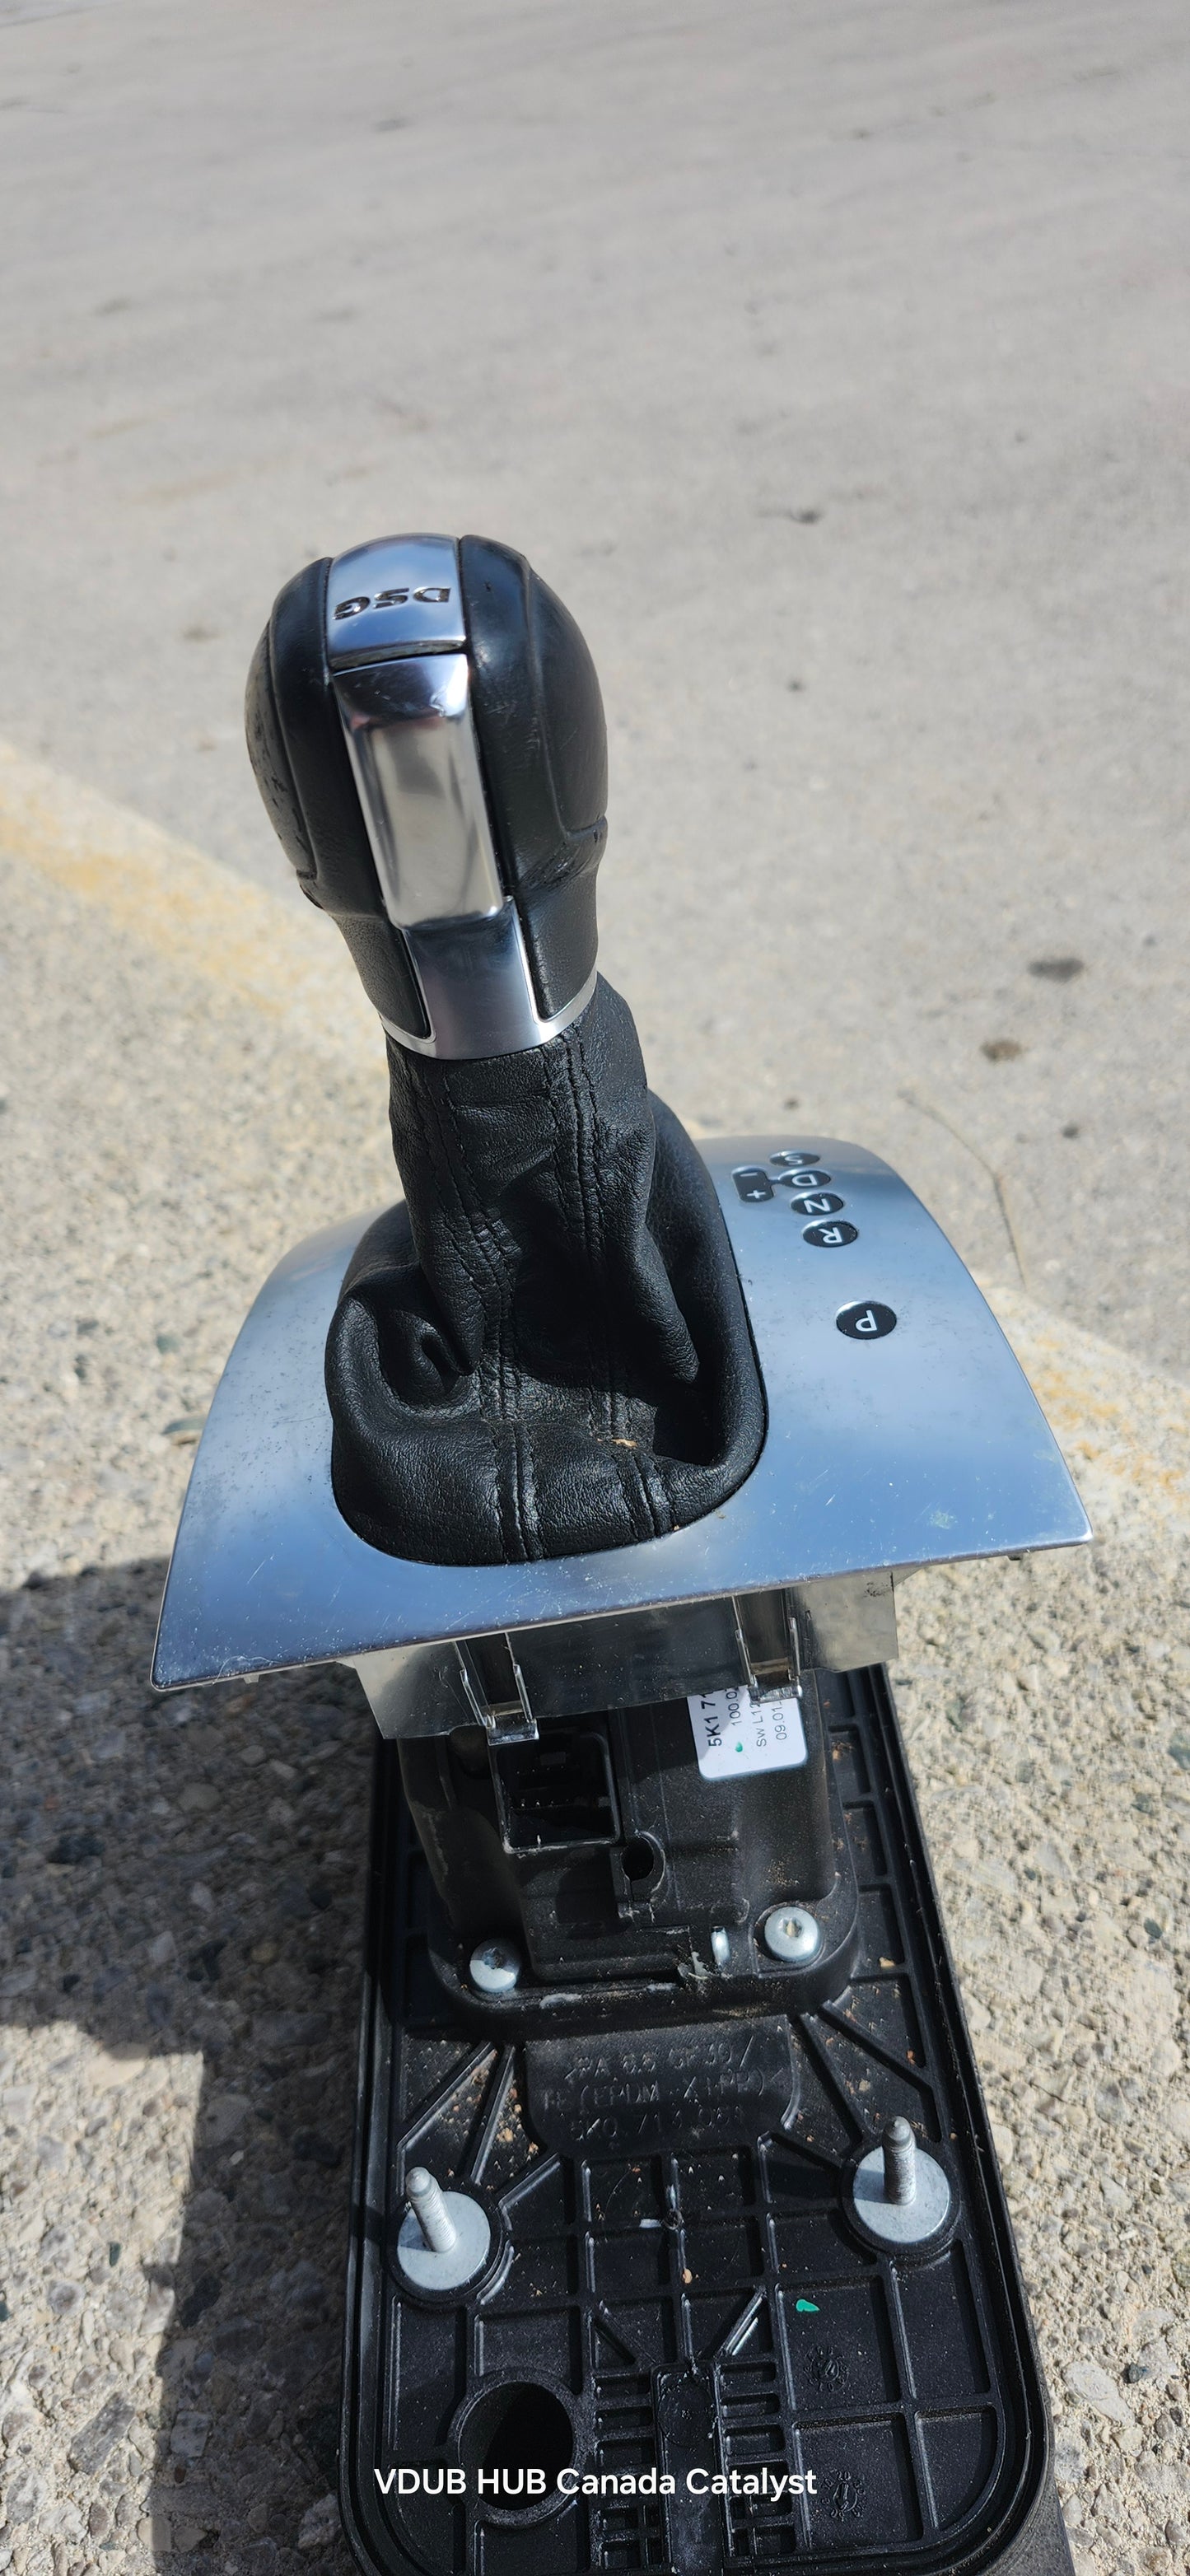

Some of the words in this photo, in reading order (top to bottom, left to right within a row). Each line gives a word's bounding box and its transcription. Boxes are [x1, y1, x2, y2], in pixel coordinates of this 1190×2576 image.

[332, 586, 451, 620] DSG
[785, 1155, 802, 1165] S
[791, 1174, 818, 1187] D
[804, 1198, 831, 1213] N
[819, 1227, 842, 1244] R
[855, 1309, 878, 1332] P
[704, 1715, 722, 1747] 5K1
